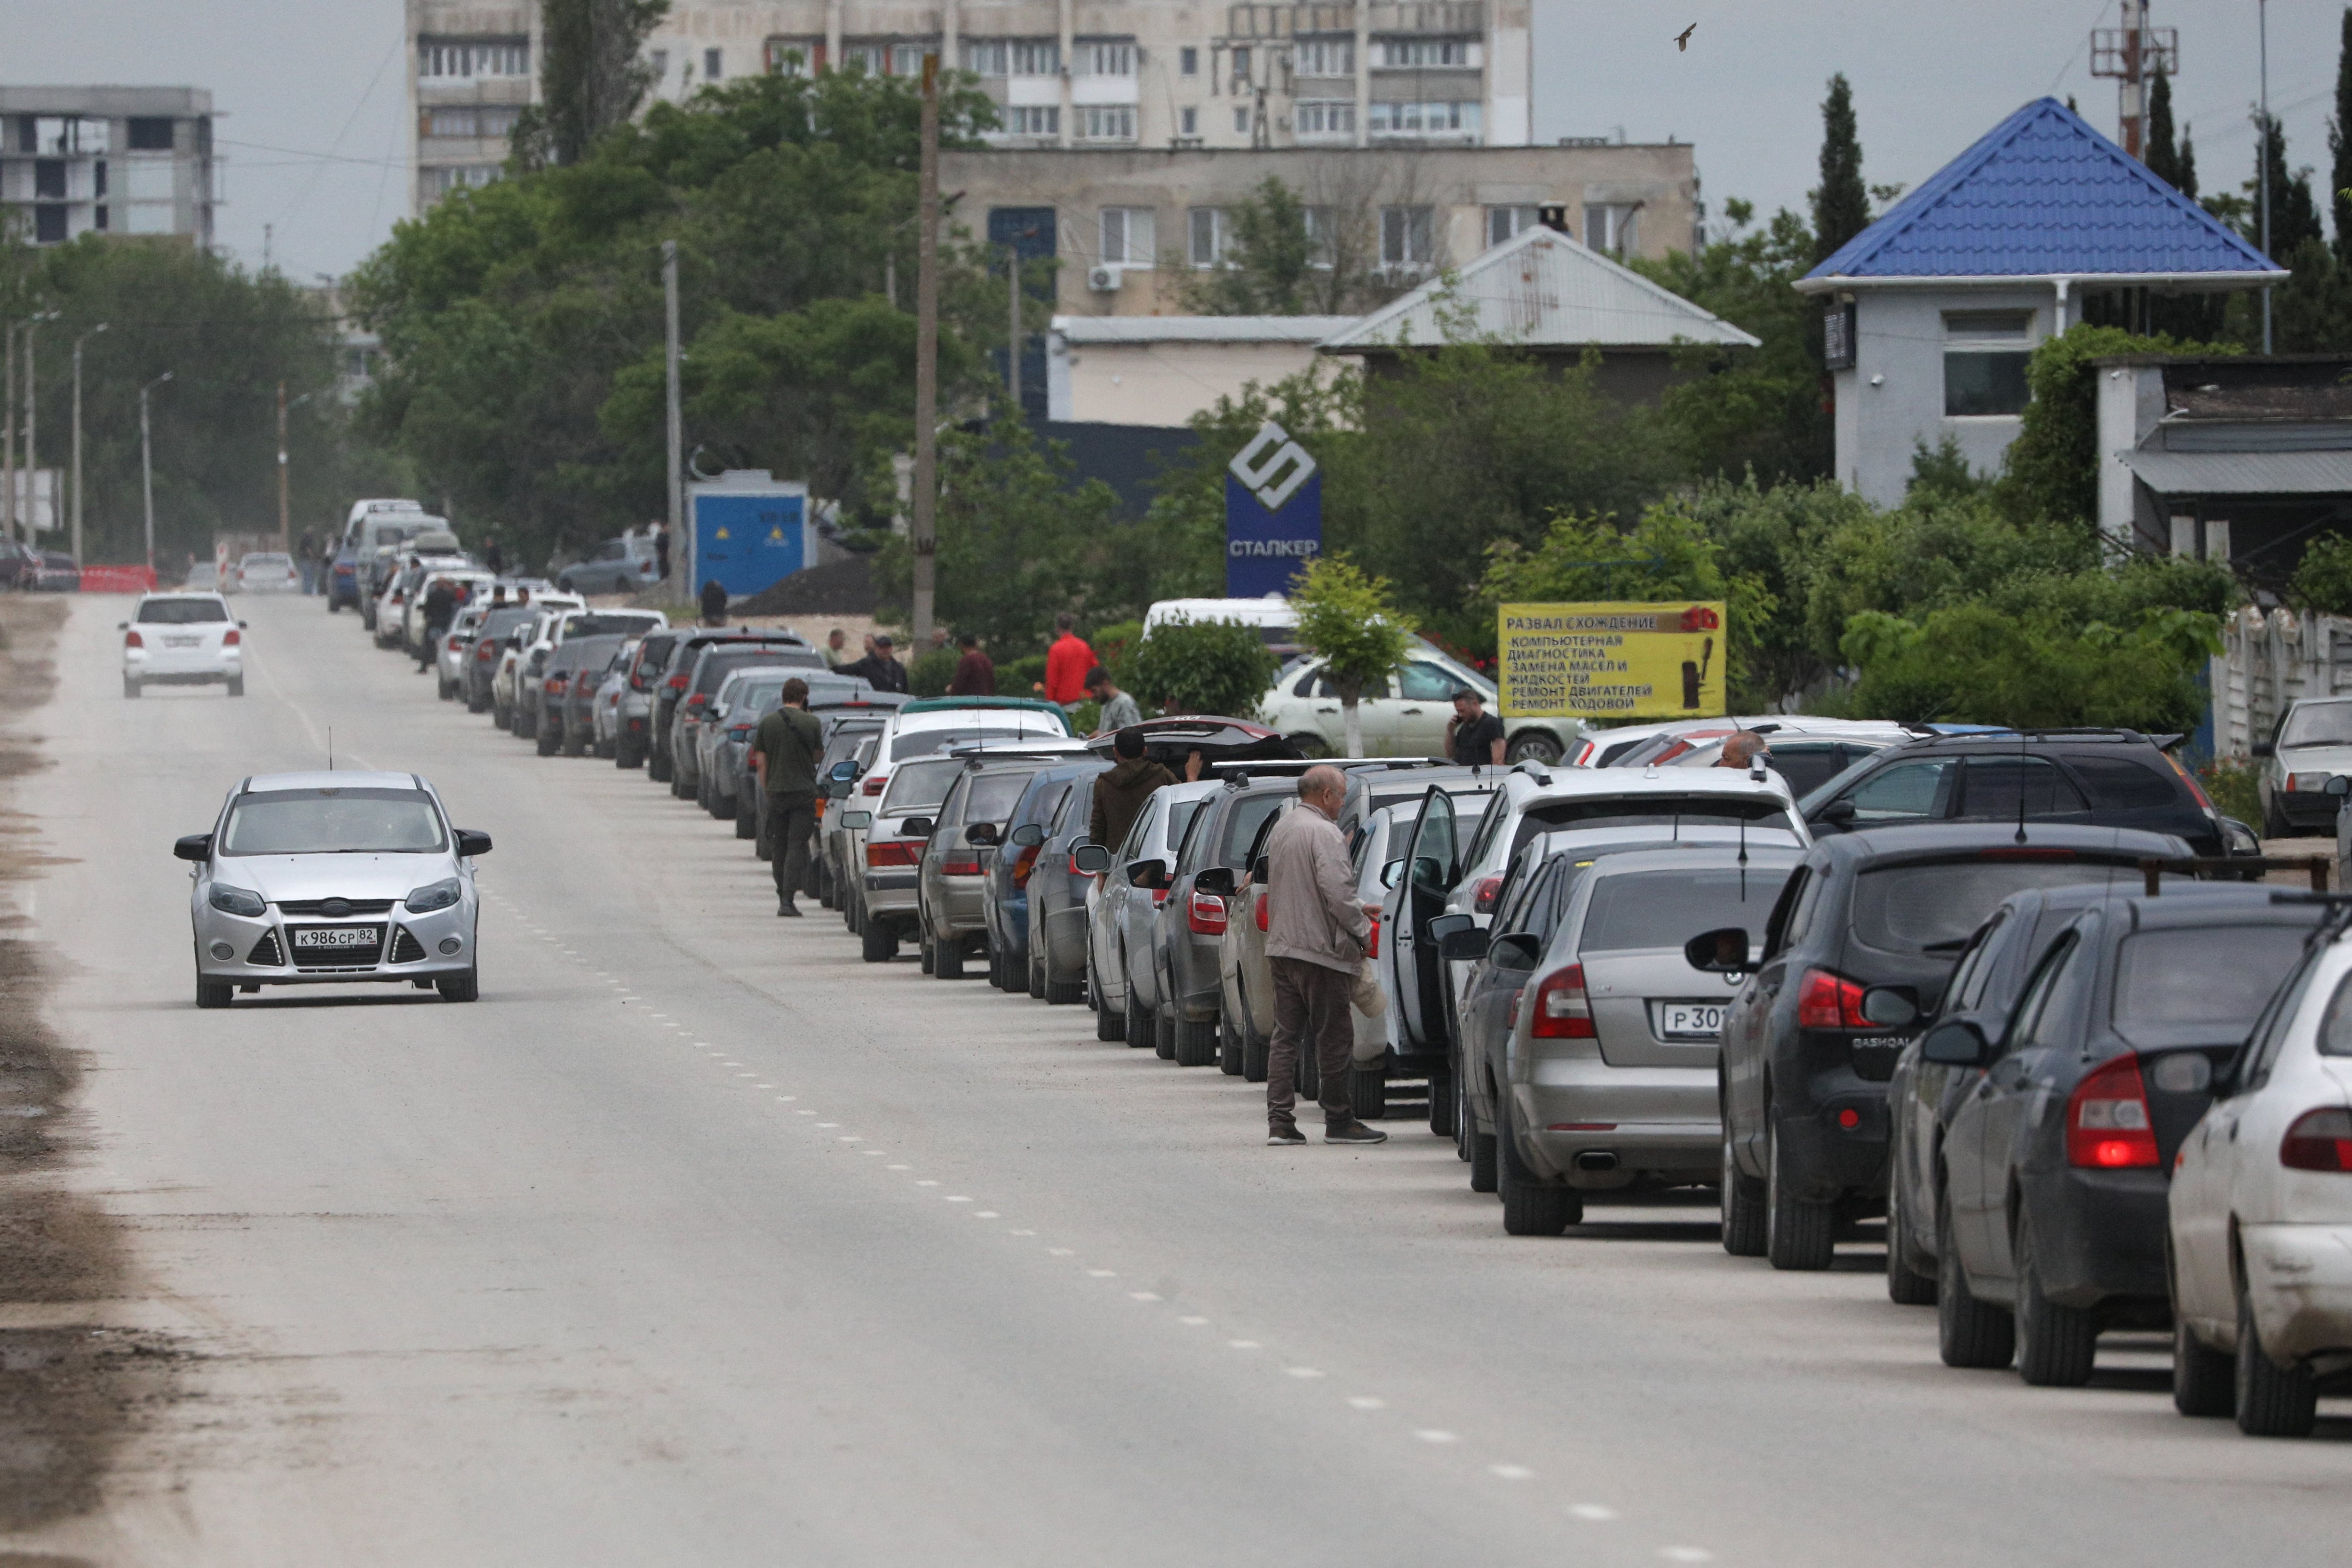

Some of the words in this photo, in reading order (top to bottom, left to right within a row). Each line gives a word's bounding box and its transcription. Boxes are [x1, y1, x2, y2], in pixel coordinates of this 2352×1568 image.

[1230, 539, 1319, 557] СТАЛКЕР
[1506, 617, 1563, 630] РАЗВАЛ
[1565, 615, 1657, 631] СХОЖДЕНИЕ
[1507, 648, 1605, 661] ДИАГНОСТИКА
[1569, 661, 1614, 672] МАСЕЛ
[1617, 660, 1628, 672] И
[1507, 672, 1590, 686] ЖИДКОСТЕЙ
[1569, 684, 1653, 698] ДВИГАТЕЛЕЙ
[359, 929, 373, 939] 82
